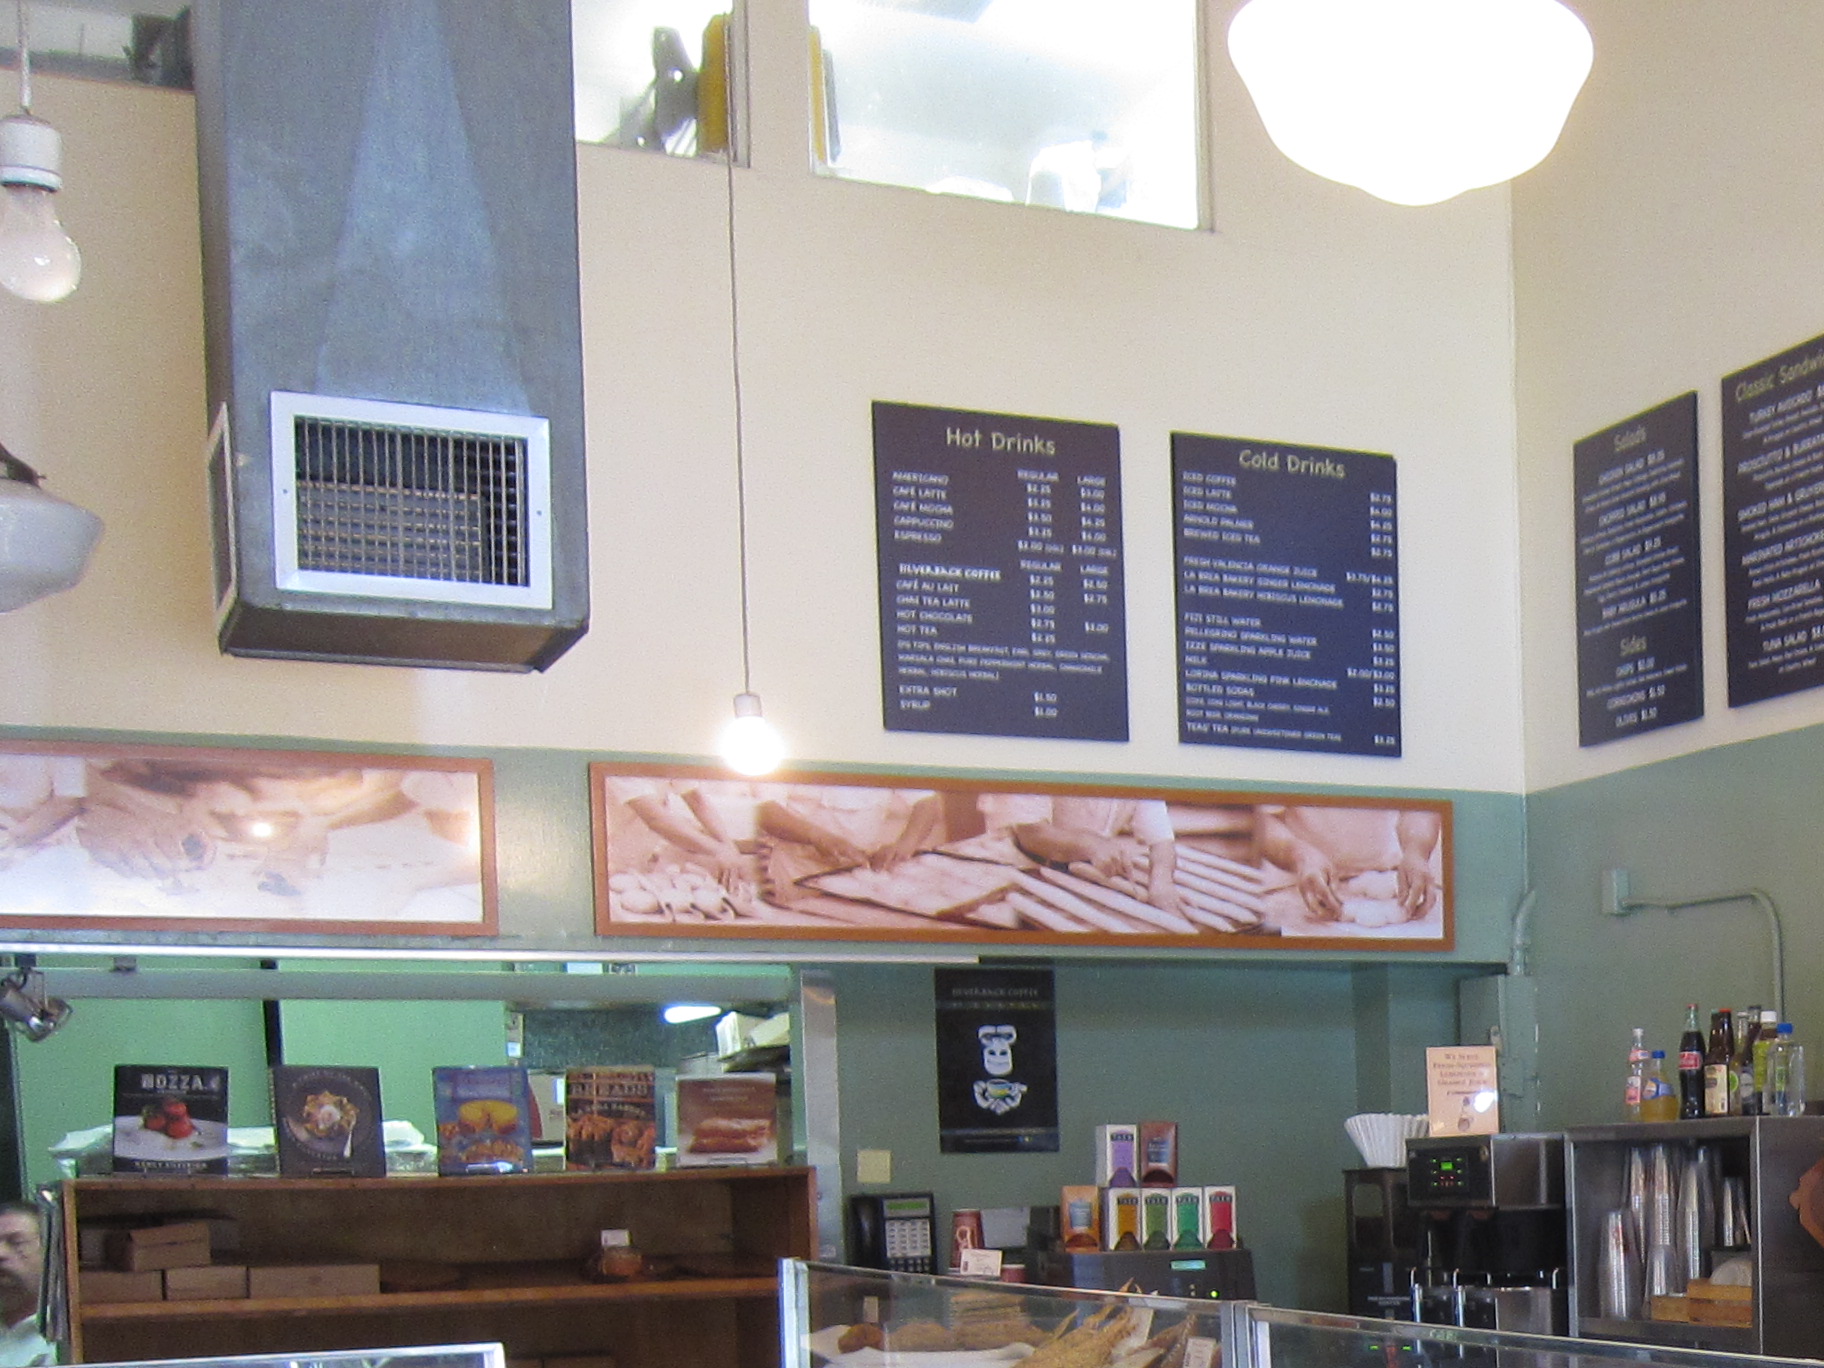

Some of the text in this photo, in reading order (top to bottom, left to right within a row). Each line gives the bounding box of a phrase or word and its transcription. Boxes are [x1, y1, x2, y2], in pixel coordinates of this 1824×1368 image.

[946, 427, 1056, 455] Hot Drinks
[1239, 449, 1347, 479] Cold Drinks
[1205, 474, 1236, 487] COFFEE
[918, 488, 947, 500] LATTE
[1244, 532, 1260, 544] TEA
[964, 568, 1001, 581] COFFEE
[922, 596, 940, 607] TEA
[942, 598, 971, 609] LATTE
[897, 610, 915, 621] HOT
[897, 624, 938, 636] HOT TEA
[899, 686, 930, 697] EXTRA
